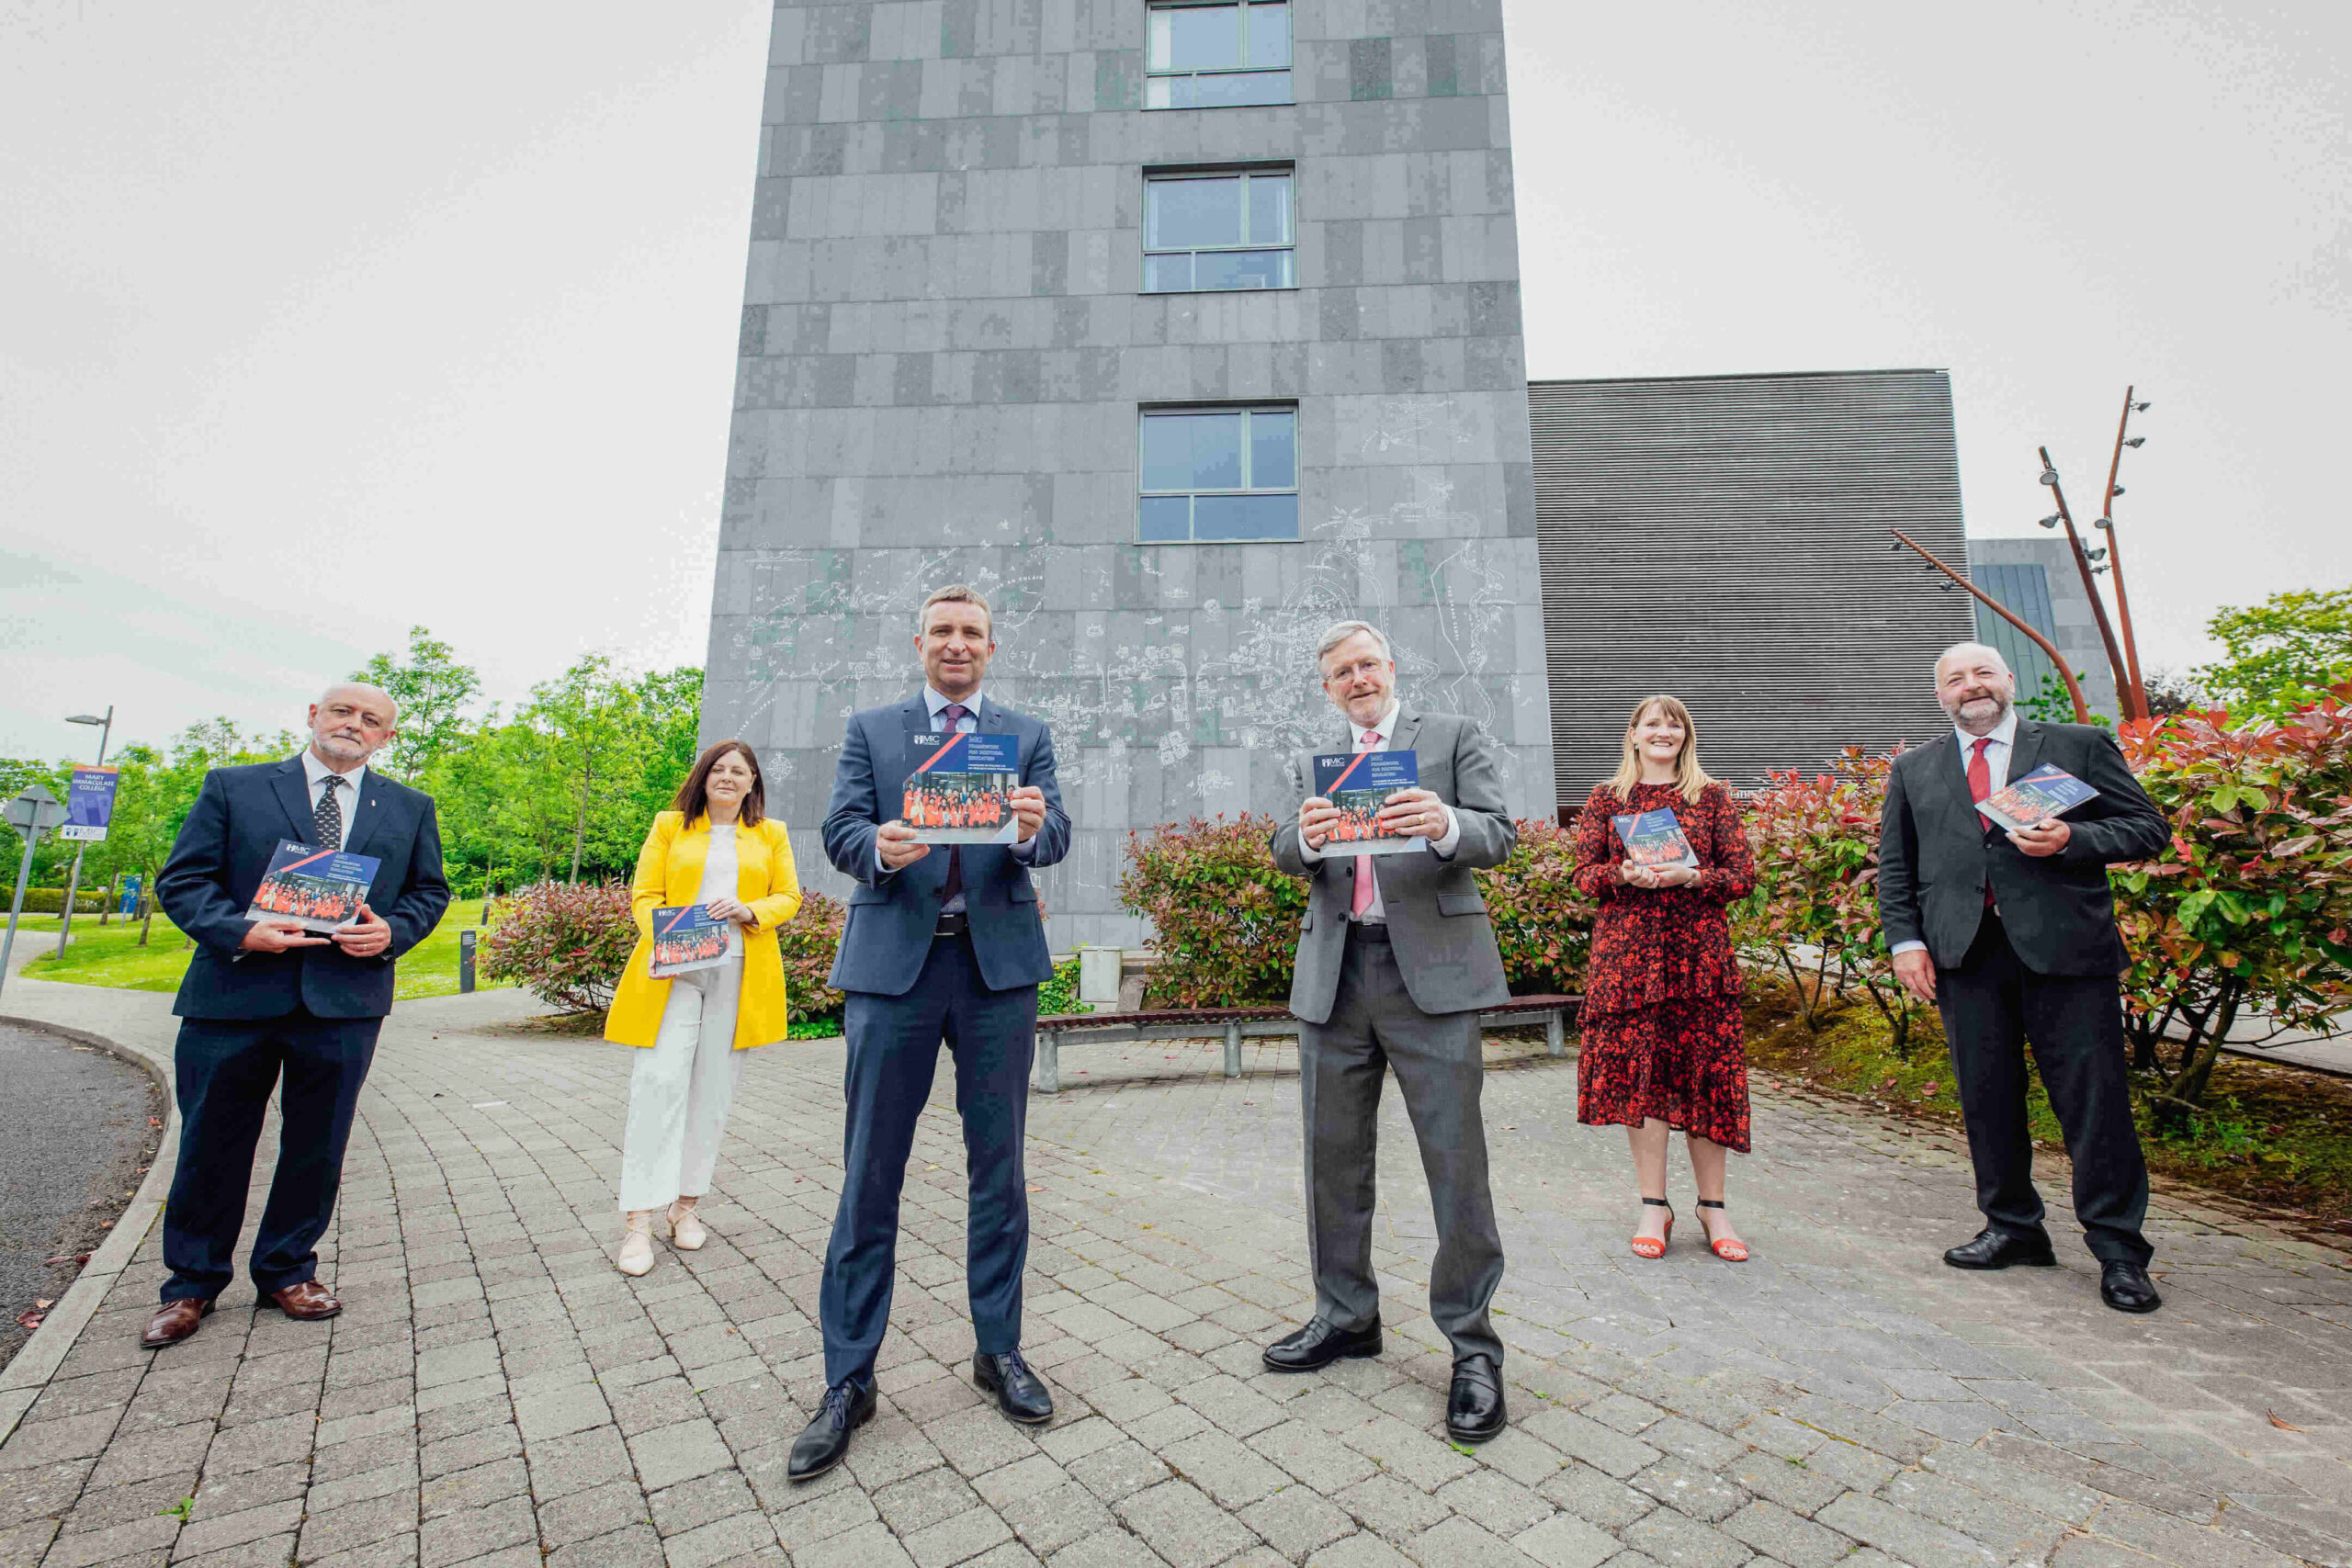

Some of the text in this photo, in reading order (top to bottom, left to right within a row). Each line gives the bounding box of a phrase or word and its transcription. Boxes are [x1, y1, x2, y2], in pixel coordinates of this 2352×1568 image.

[923, 735, 941, 743] MIC
[1329, 757, 1345, 765] MIC
[74, 779, 115, 787] IMMACULATE
[295, 844, 311, 854] MIC
